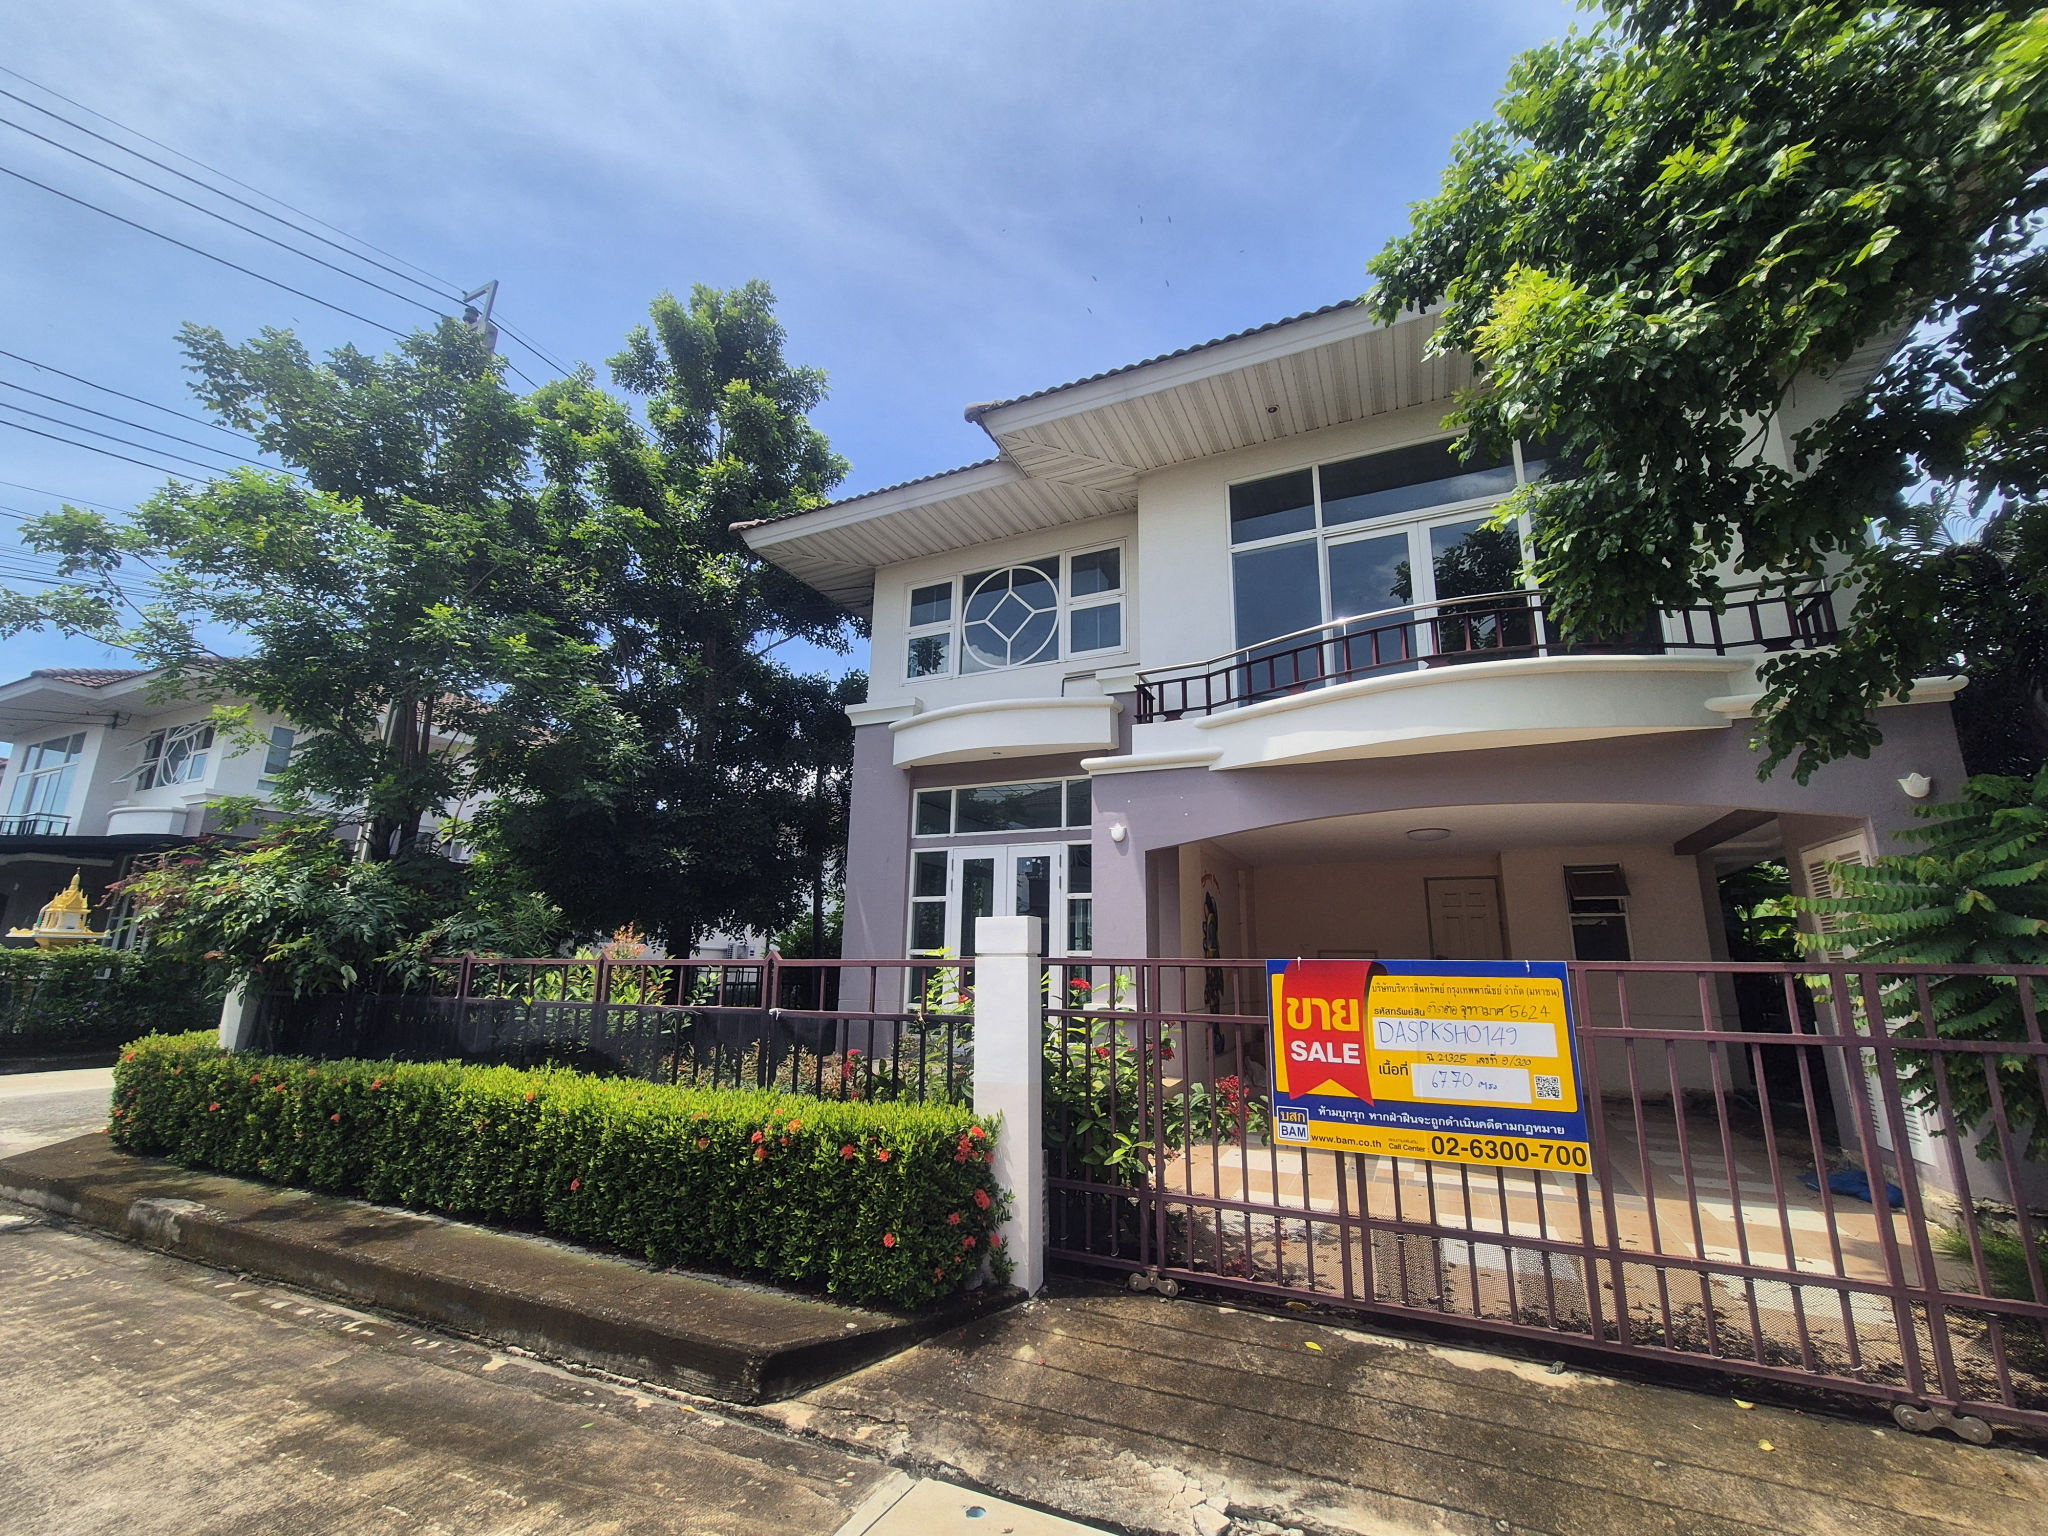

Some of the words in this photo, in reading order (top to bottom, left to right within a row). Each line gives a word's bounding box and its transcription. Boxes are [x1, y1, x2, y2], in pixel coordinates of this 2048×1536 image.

[1372, 982, 1445, 993] บริษัทบริหารสินทรัพย์
[1446, 983, 1502, 997] กรุงเทพพาณิชย์
[1504, 984, 1525, 996] จำกัด
[1526, 986, 1560, 998] (มหาชน)
[1286, 997, 1361, 1032] ขาย
[1374, 1006, 1426, 1017] รหัสทรัพย์สิน
[1509, 1004, 1551, 1020] 5624
[1290, 1040, 1361, 1065] SALE
[1438, 1053, 1468, 1064] 21325
[1378, 1059, 1409, 1077] เนื้อที่
[1279, 1110, 1306, 1123] บสก
[1318, 1105, 1365, 1122] ห้ามบุกรุก
[1368, 1111, 1566, 1136] หากฝ่าฝืนจะถูกดำเนินคดีตามกฎหมาย
[1281, 1125, 1307, 1138] BAM
[1311, 1135, 1382, 1149] www.bam.co.th
[1388, 1142, 1402, 1151] Call
[1431, 1135, 1588, 1168] 02-6300-700
